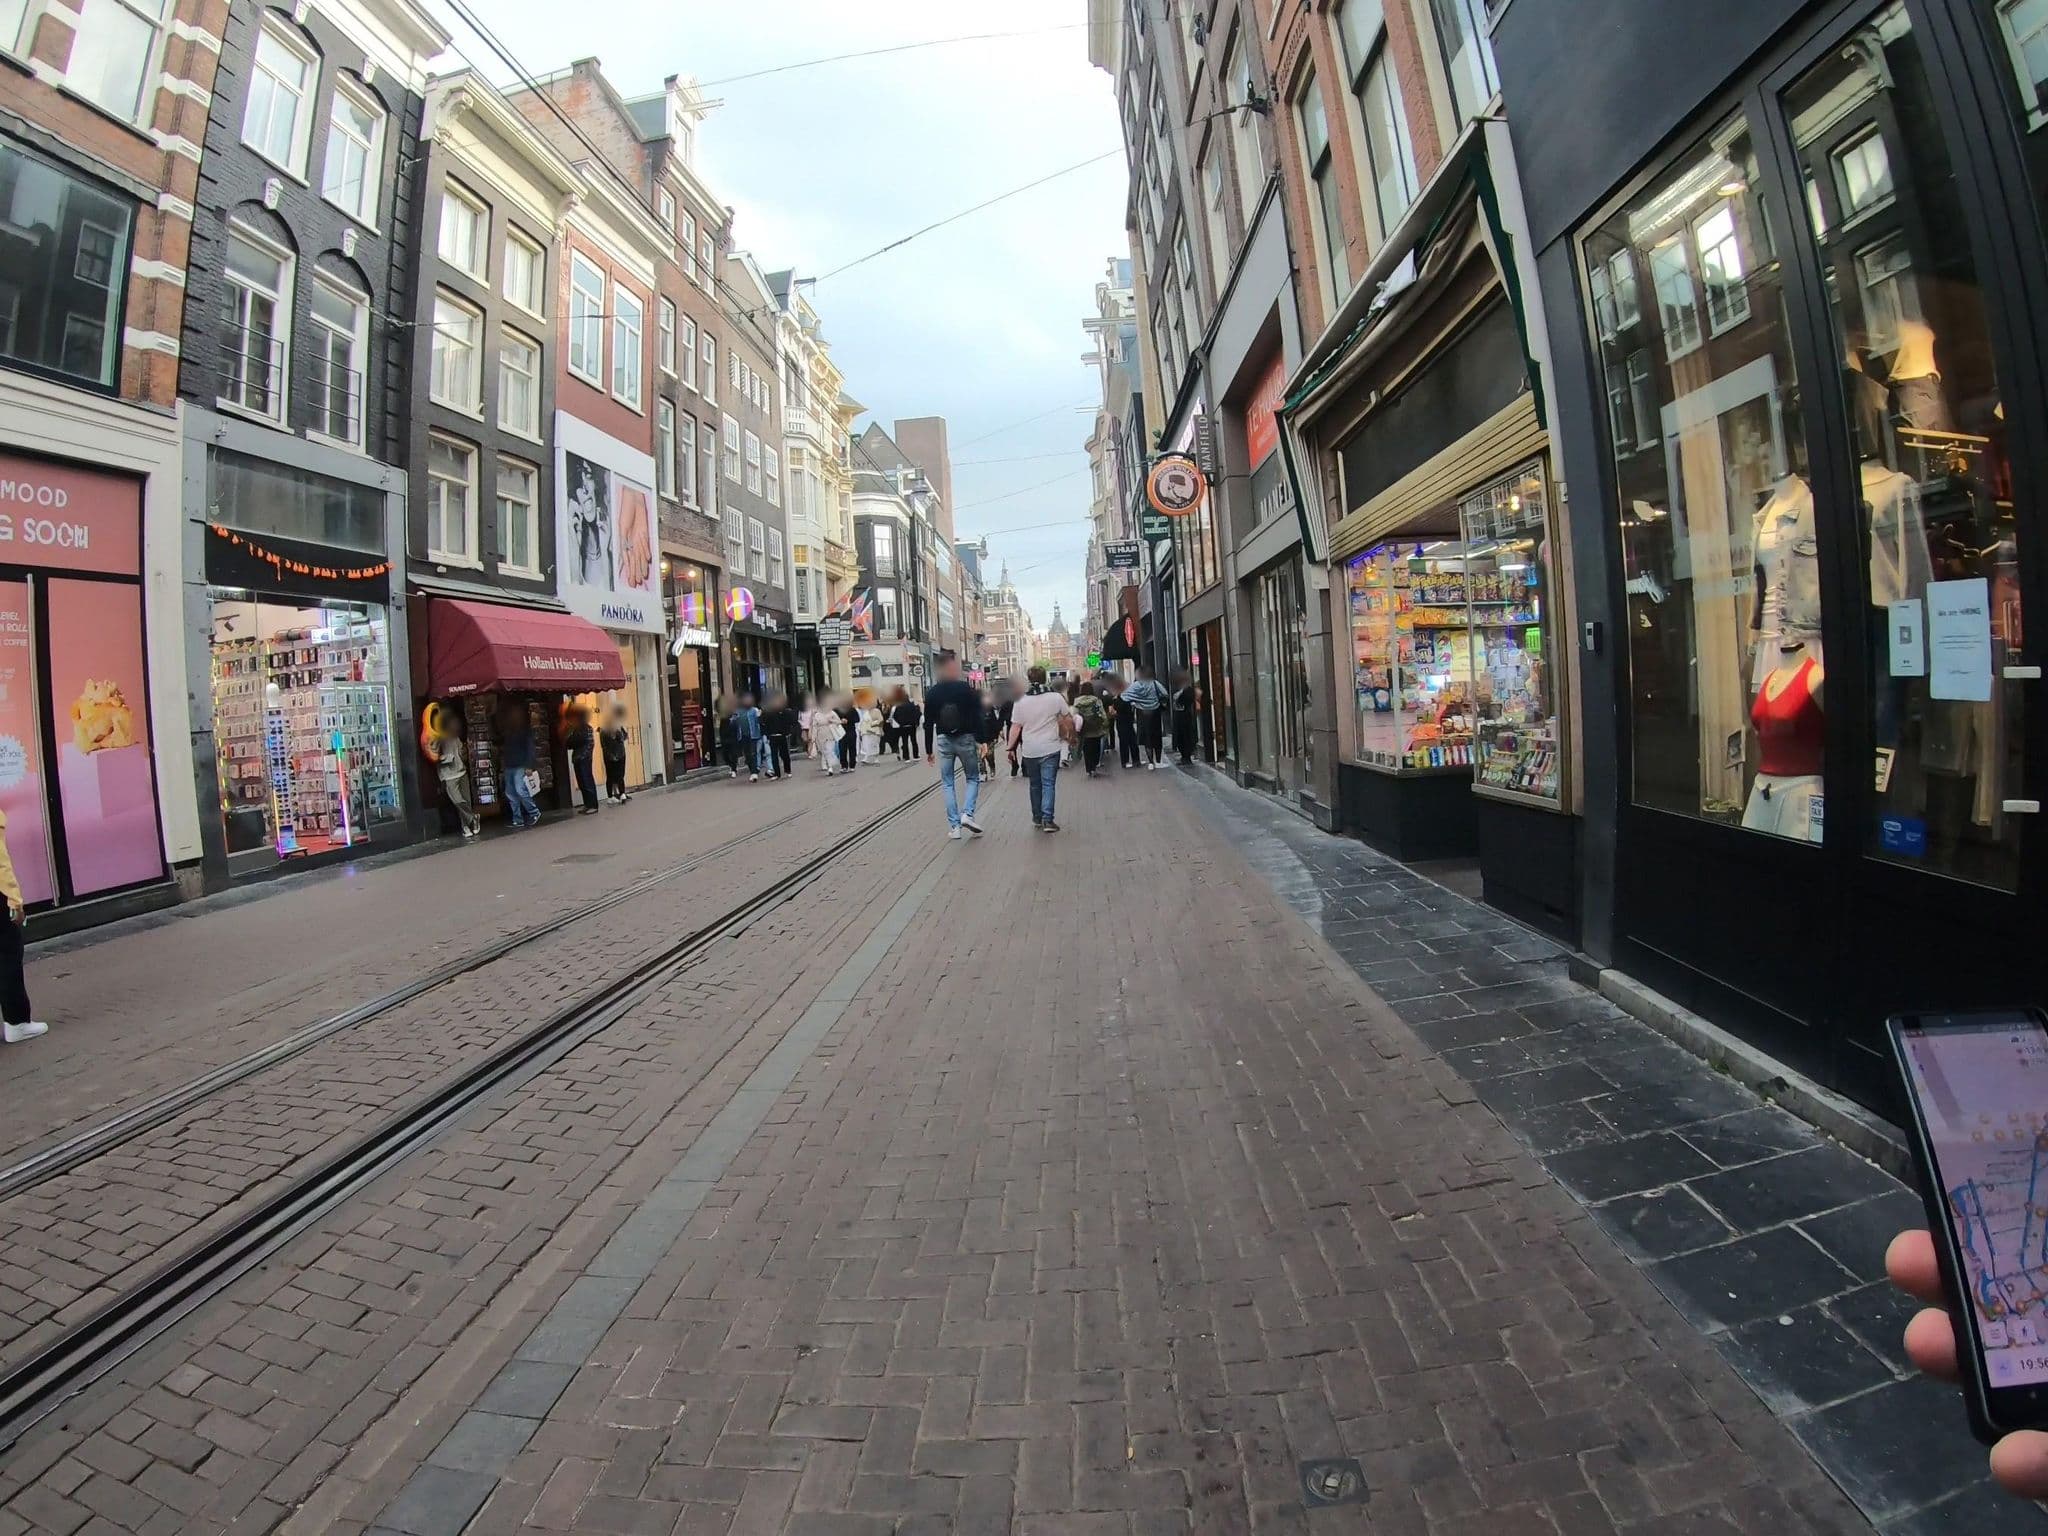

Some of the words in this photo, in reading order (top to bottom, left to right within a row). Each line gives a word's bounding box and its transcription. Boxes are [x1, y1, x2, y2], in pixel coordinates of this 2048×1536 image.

[1199, 416, 1212, 471] MANFIELD
[1, 480, 68, 508] MOOD
[24, 518, 89, 549] SOON
[601, 603, 644, 624] PANDORA
[523, 655, 555, 670] Holland
[554, 657, 573, 670] Huis
[572, 658, 604, 671] Souvenirs
